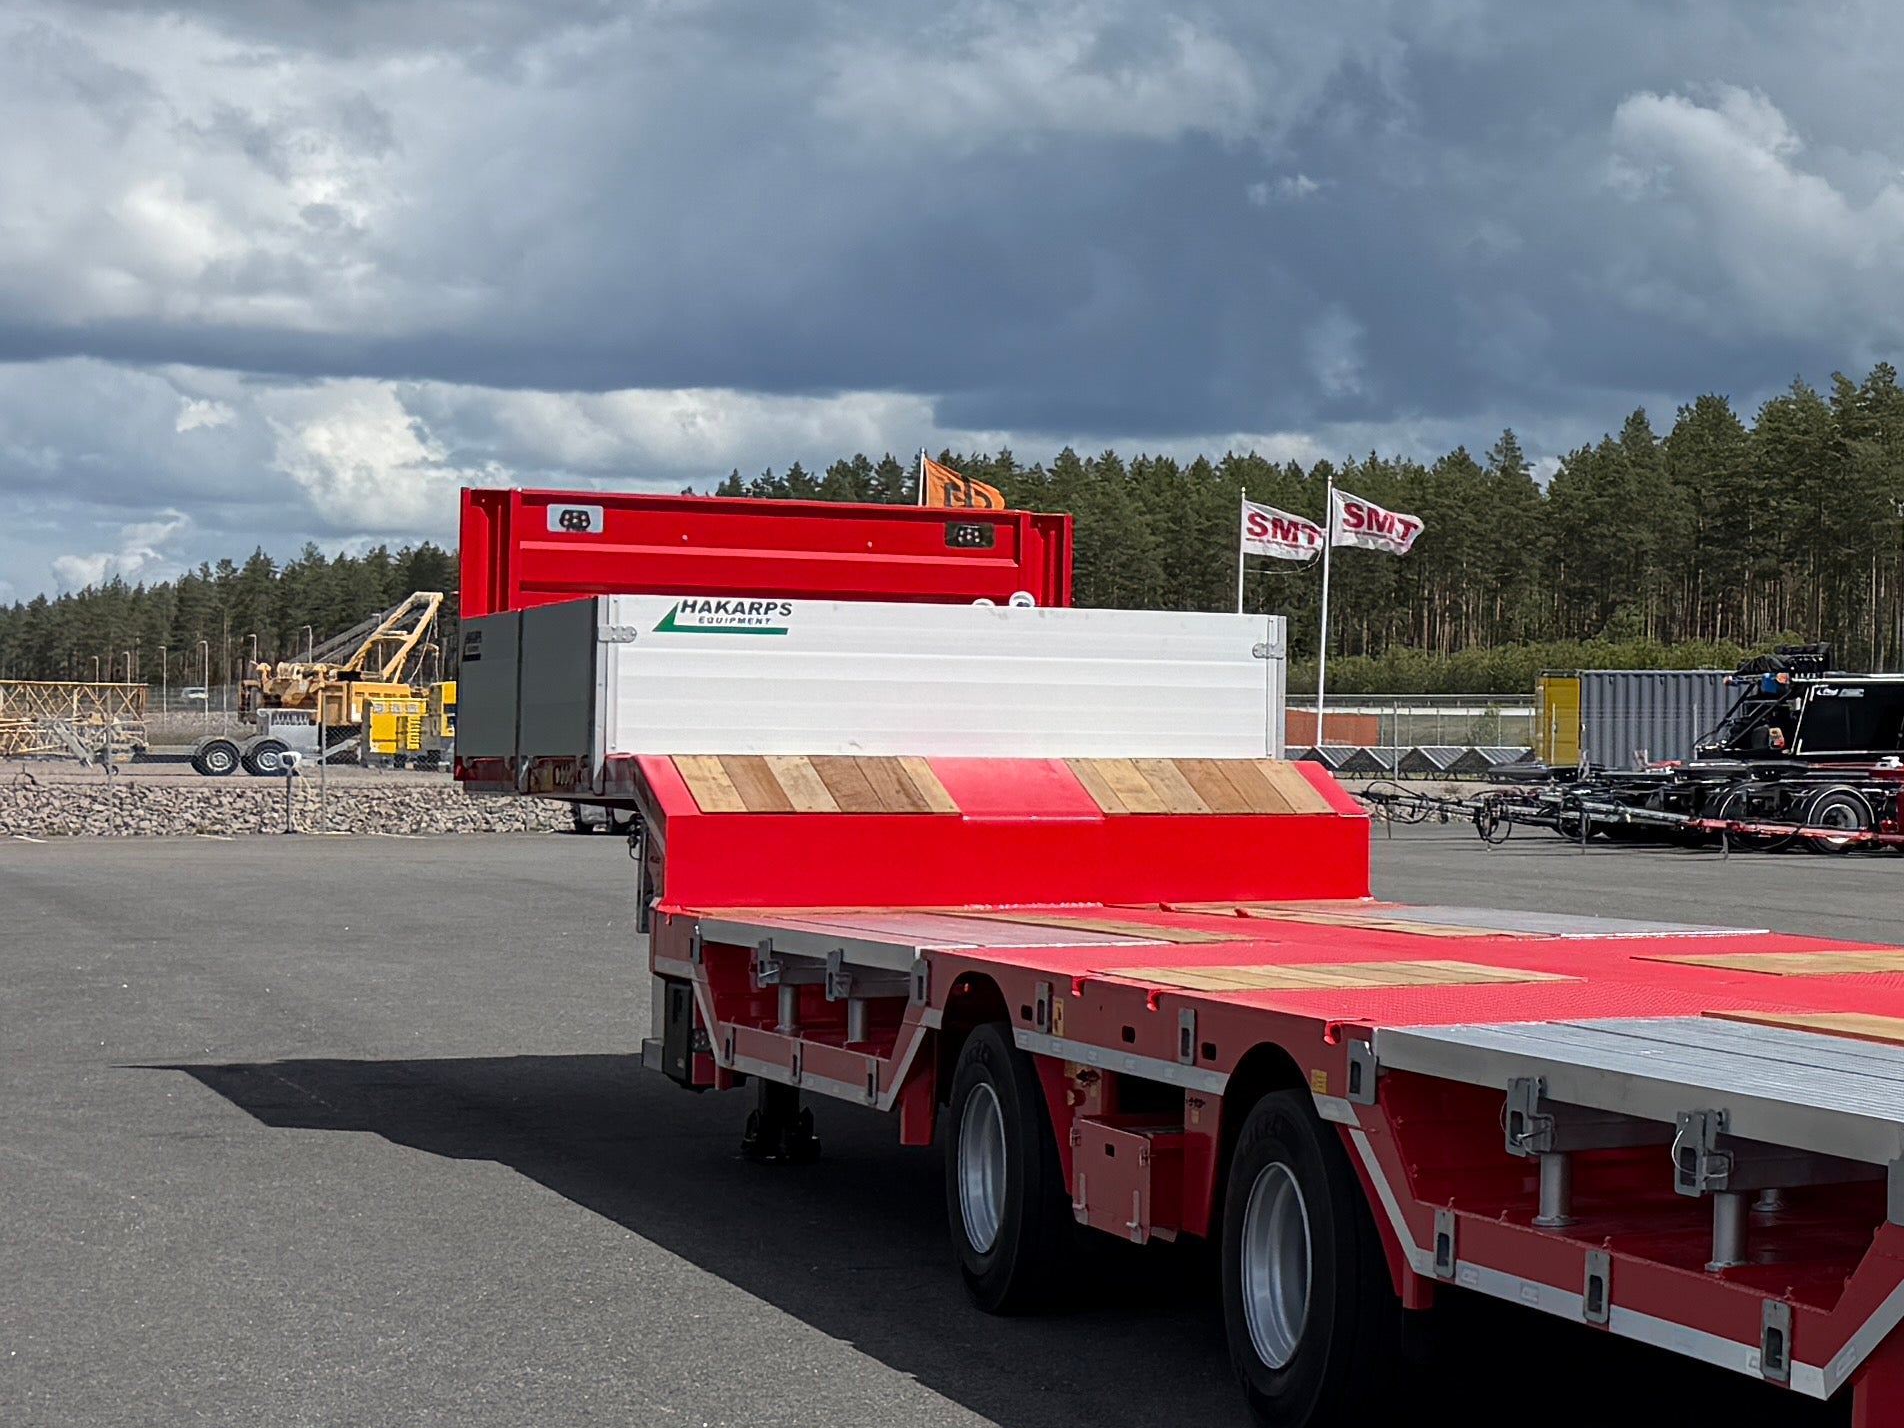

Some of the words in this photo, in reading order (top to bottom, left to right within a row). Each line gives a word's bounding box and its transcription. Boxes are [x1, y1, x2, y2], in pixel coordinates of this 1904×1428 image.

[1246, 512, 1323, 546] SMT
[1343, 501, 1419, 542] SMT
[680, 599, 793, 617] HAKARPS
[698, 615, 771, 626] EQUIPMENT
